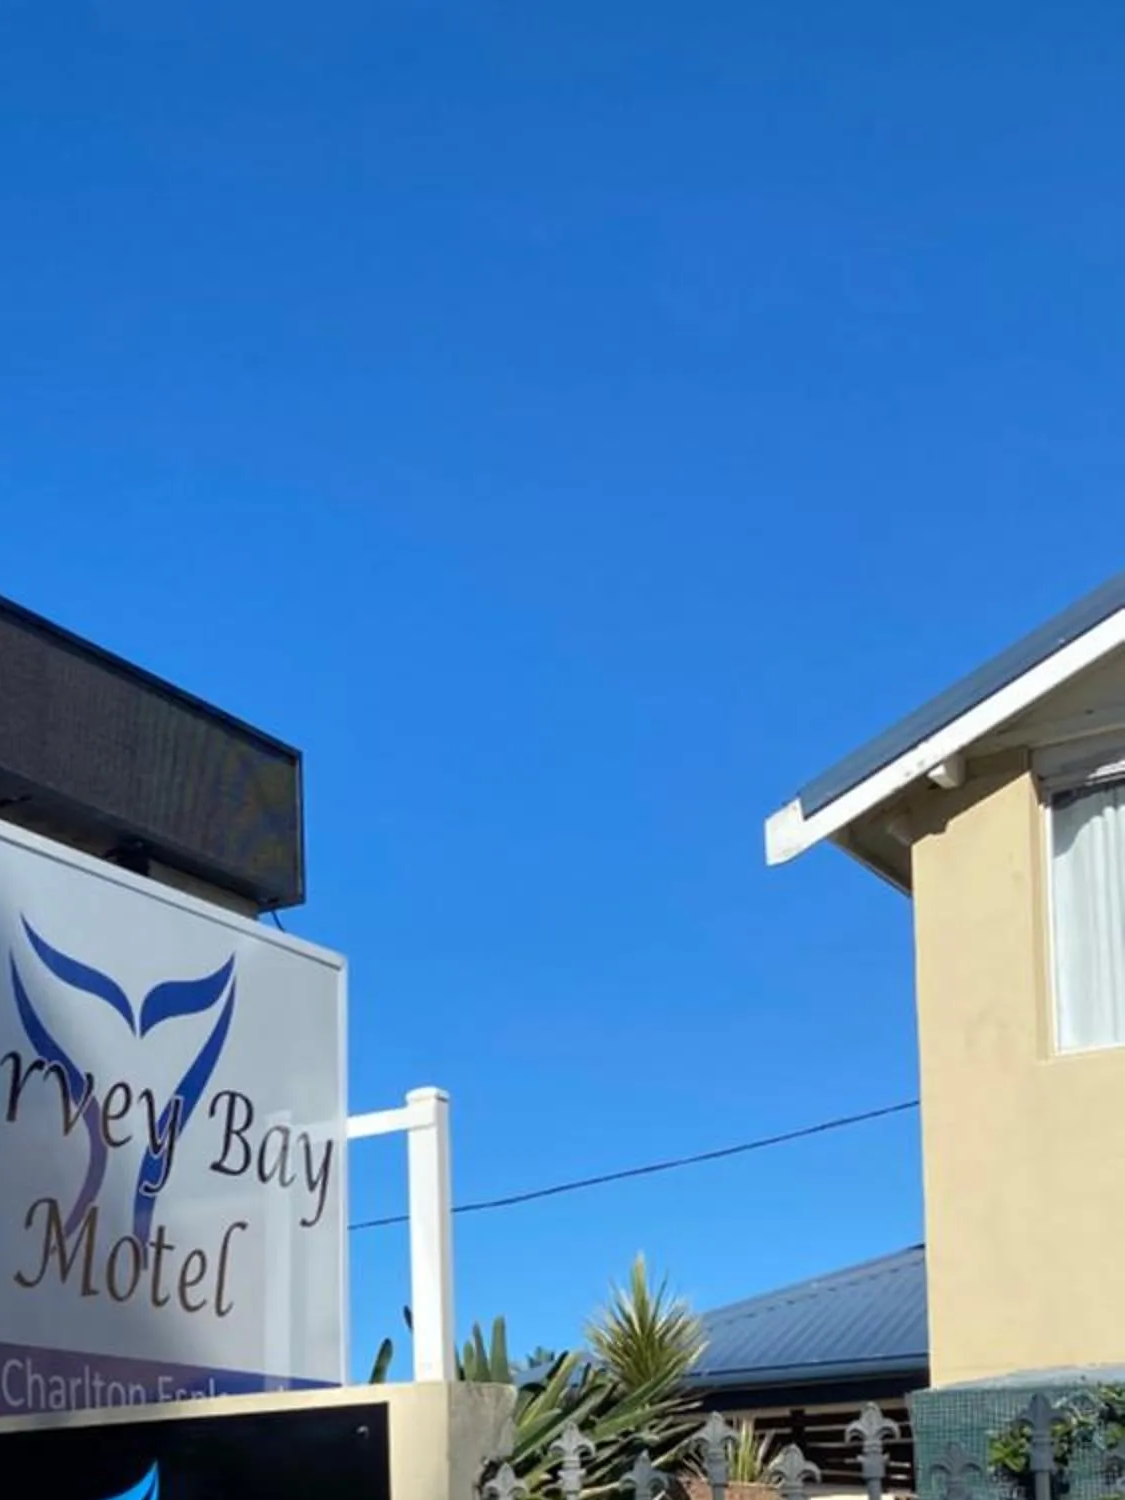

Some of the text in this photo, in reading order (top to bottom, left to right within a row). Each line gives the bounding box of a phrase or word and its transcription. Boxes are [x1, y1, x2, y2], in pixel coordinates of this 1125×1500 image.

[209, 1088, 334, 1229] Bay
[13, 1197, 247, 1318] Motel
[1, 1357, 147, 1411] Charlton
